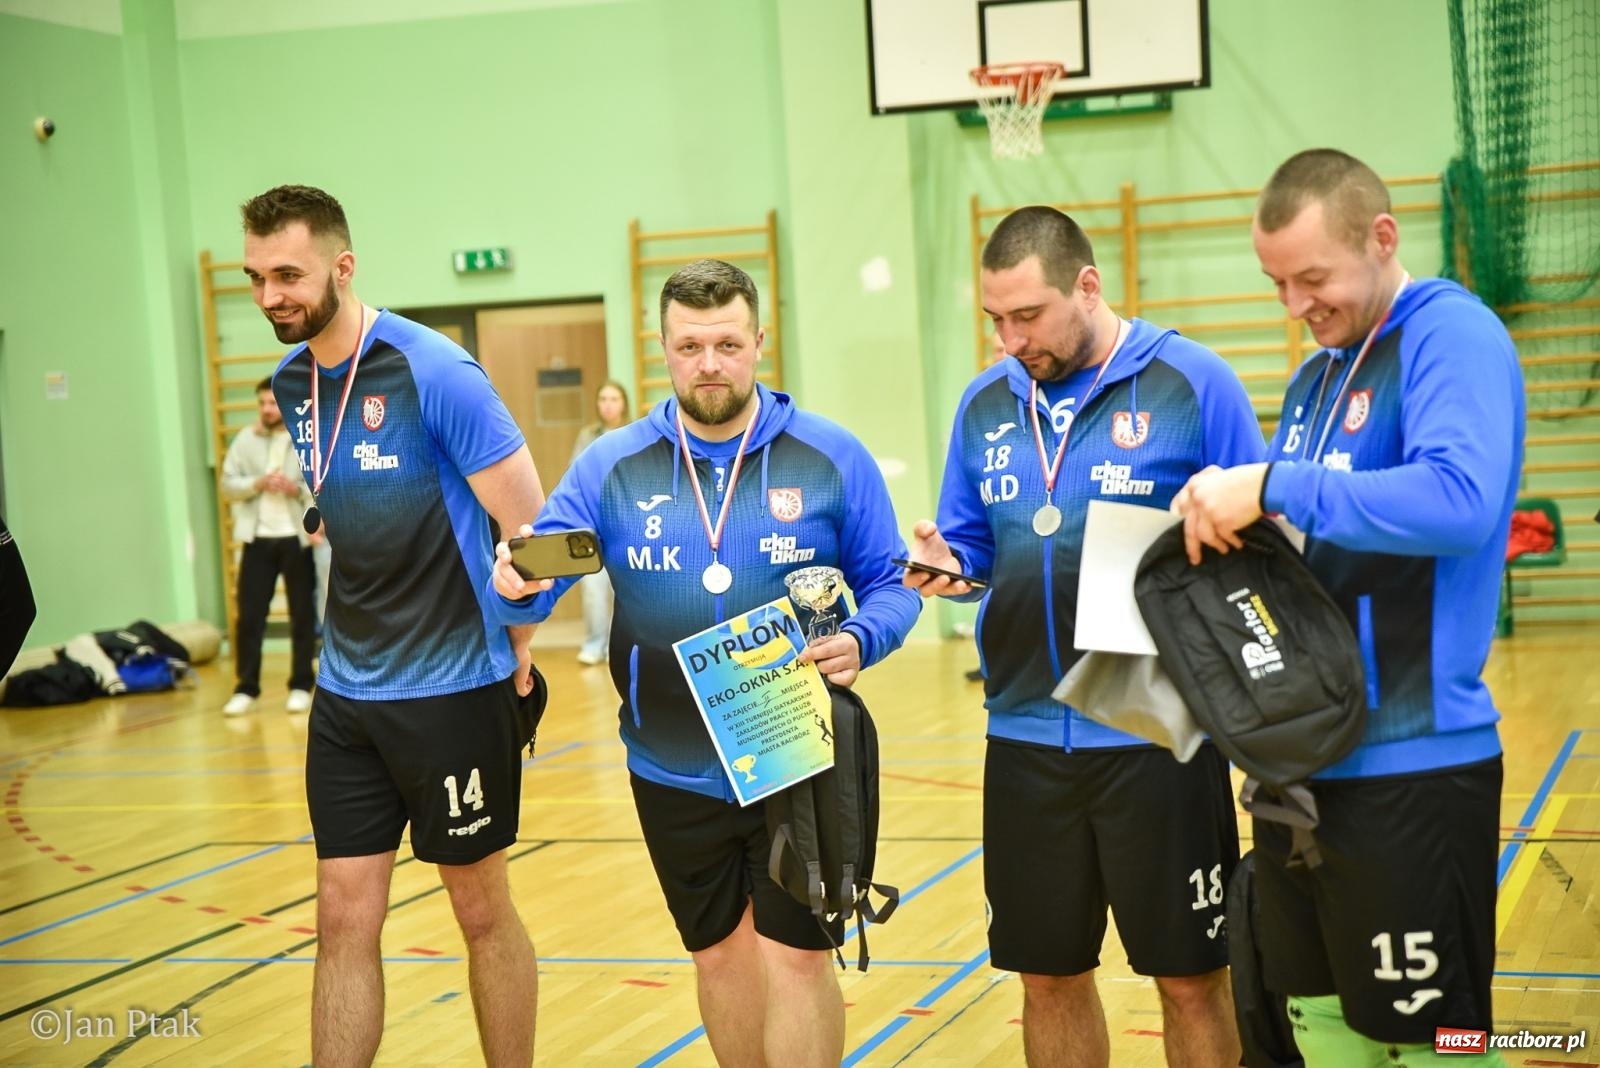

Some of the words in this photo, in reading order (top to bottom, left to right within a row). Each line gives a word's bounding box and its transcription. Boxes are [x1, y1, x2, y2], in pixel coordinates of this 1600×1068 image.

[983, 445, 1012, 473] 18
[979, 474, 1019, 506] M.D
[645, 515, 662, 539] 8
[627, 546, 681, 571] M.K
[688, 614, 795, 674] DYPLOM
[706, 668, 781, 708] EKO-OKNA
[721, 712, 731, 721] ZA
[781, 679, 808, 695] MIEJSCA
[745, 708, 773, 723] TURNIEJU
[773, 690, 812, 711] SIATKARSKIM
[735, 719, 768, 737] ZAKŁADÓW
[769, 710, 788, 722] PRACY
[736, 721, 786, 746] MUNDUROWYCH
[792, 707, 816, 721] PUCHAR
[760, 725, 798, 745] PREZYDENTA
[757, 742, 780, 756] MIASTA
[780, 729, 810, 745] RACIBÓRZ
[444, 768, 483, 817] 14
[448, 816, 491, 836] regio
[1189, 864, 1223, 910] 18
[1372, 931, 1439, 980] 15
